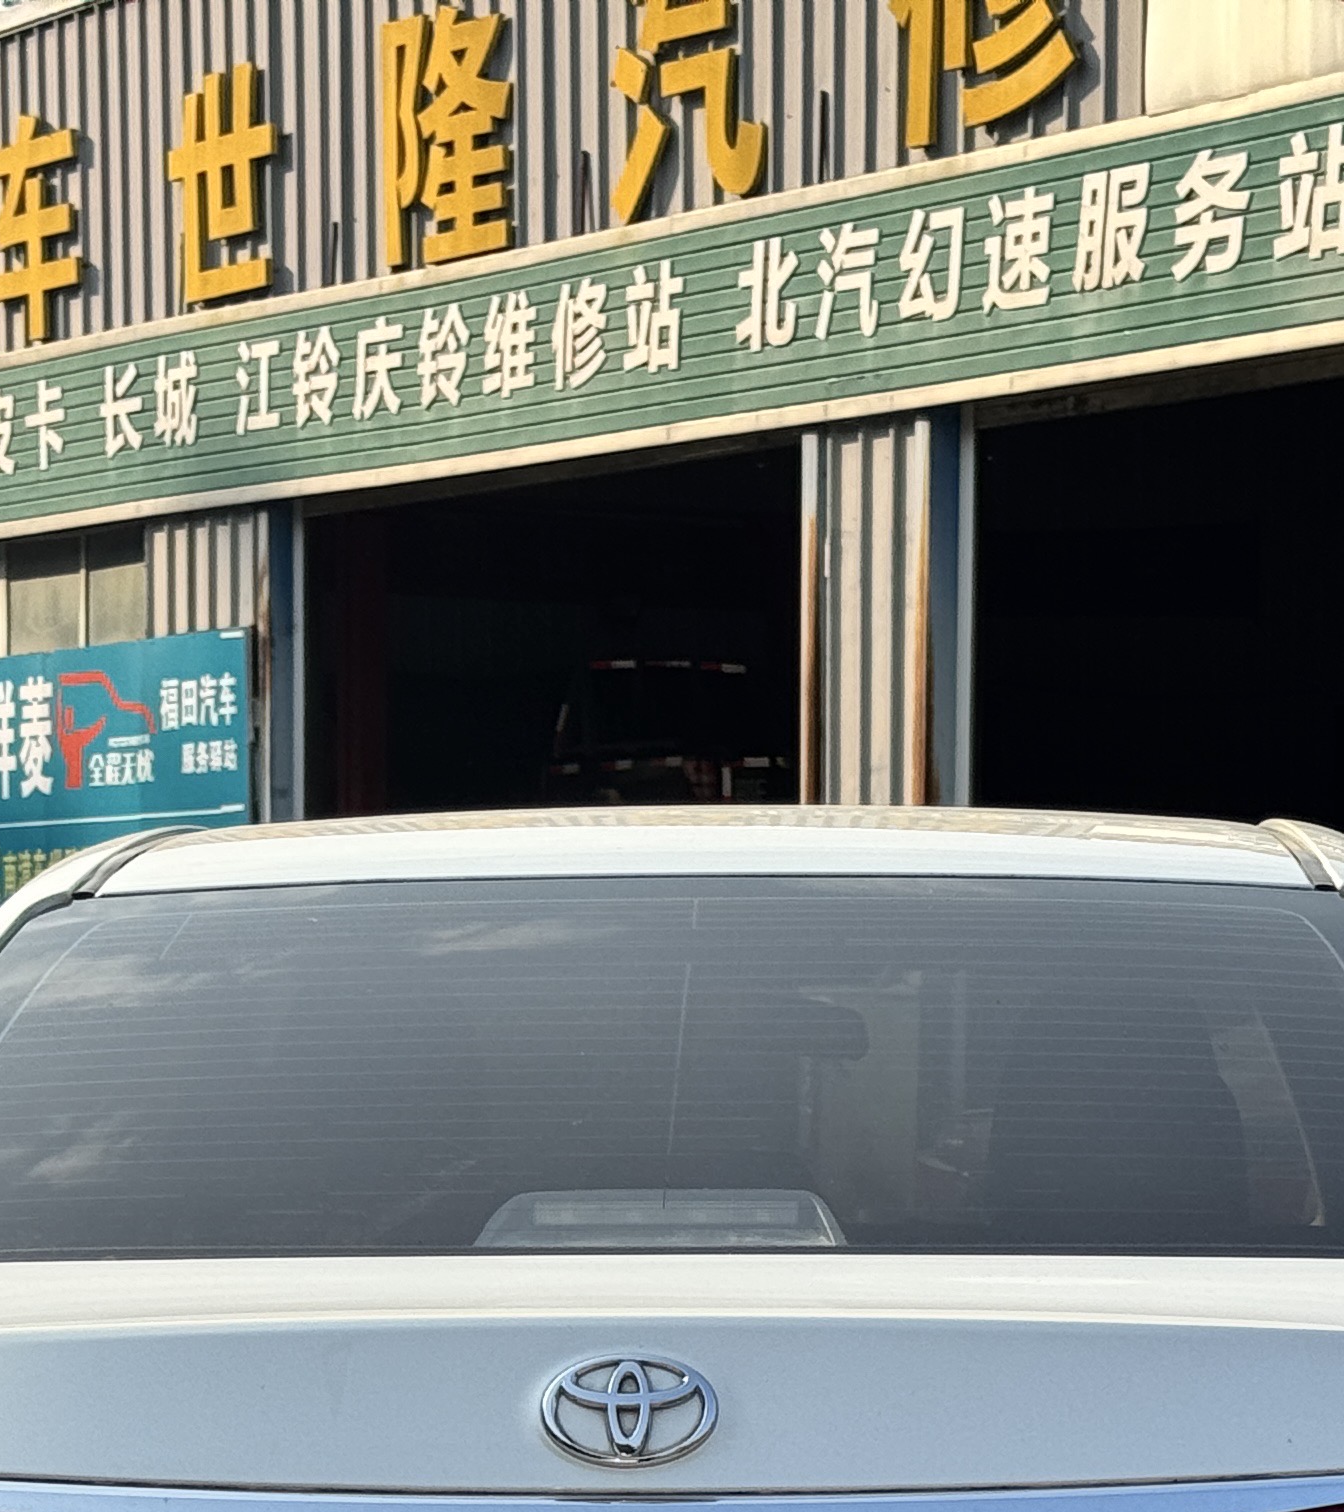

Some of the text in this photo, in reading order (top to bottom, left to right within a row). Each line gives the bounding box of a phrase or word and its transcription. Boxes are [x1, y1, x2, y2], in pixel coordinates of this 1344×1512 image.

[100, 350, 199, 458] 长城
[235, 258, 685, 435] 江铃庆铃维修站
[159, 671, 238, 732] 福田汽车
